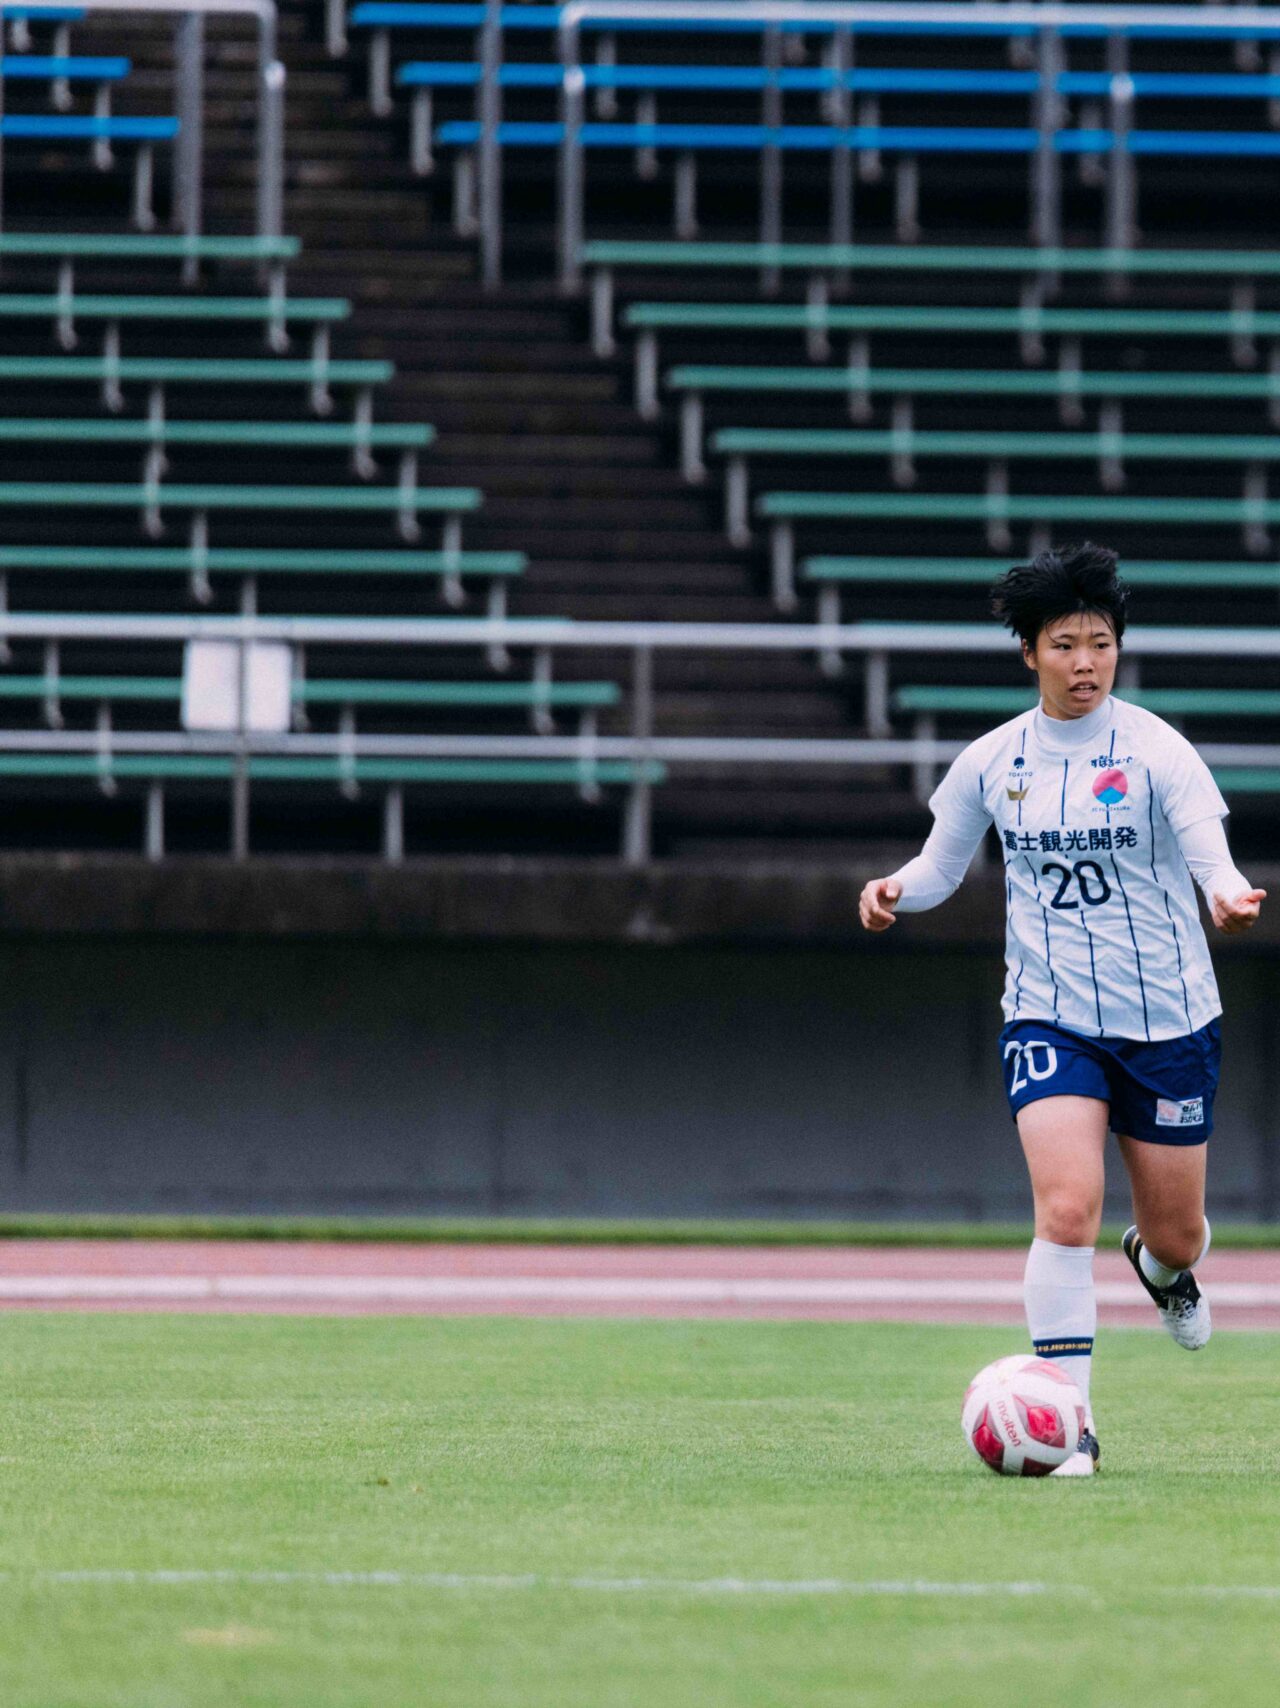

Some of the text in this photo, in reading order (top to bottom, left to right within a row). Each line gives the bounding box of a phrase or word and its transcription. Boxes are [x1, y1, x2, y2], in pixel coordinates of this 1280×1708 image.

[1004, 826, 1138, 852] 富士観光開発
[1041, 860, 1112, 910] 20
[1004, 1040, 1058, 1096] 20
[997, 1400, 1022, 1448] molten
